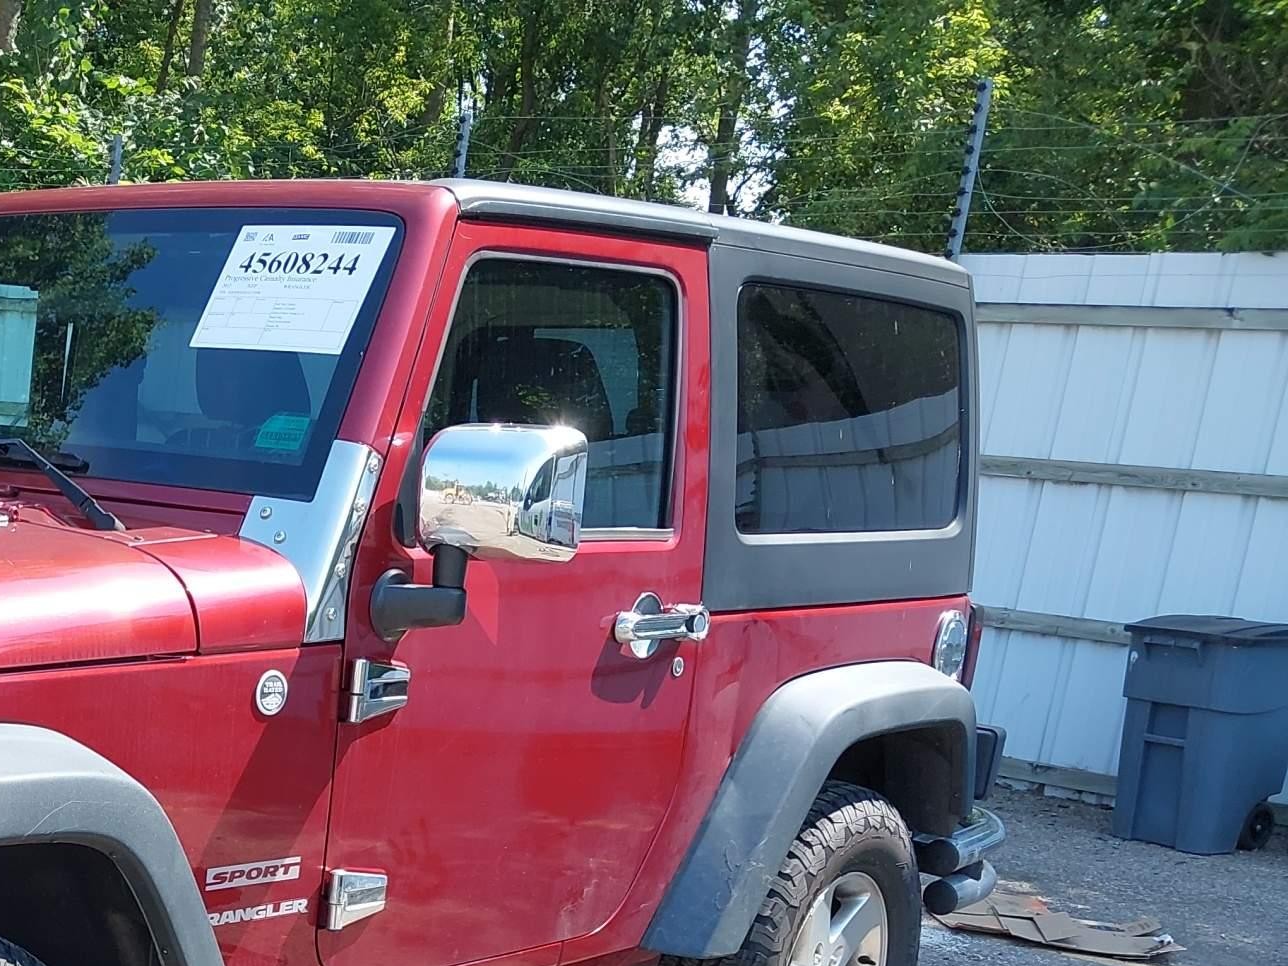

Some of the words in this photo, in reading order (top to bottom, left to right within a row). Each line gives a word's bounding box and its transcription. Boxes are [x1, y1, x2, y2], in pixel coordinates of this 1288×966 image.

[239, 251, 361, 276] 45608244
[206, 861, 300, 887] SPORT
[208, 899, 309, 926] RANGLER
